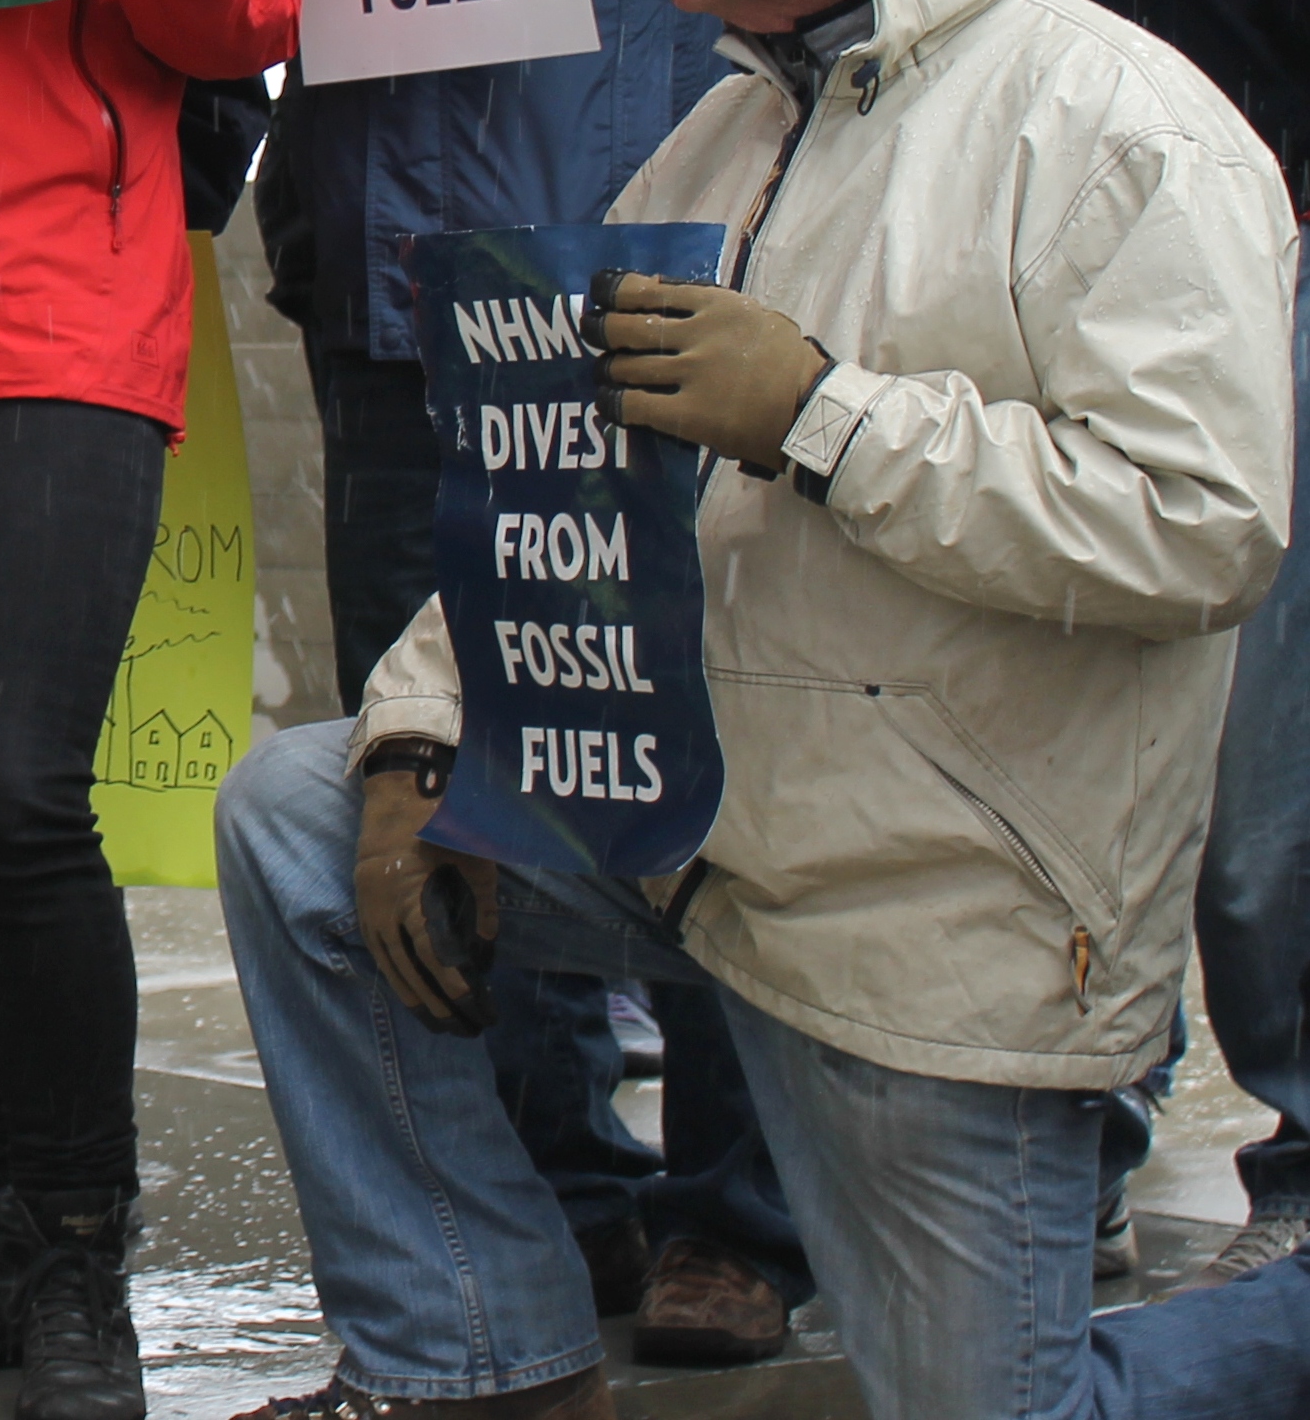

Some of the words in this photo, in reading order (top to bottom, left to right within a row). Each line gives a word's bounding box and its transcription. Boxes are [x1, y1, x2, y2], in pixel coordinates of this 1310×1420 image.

[151, 522, 243, 584] ROM
[494, 511, 630, 581] FROM
[493, 620, 654, 693] FOSSIL
[520, 726, 663, 802] FUELS
